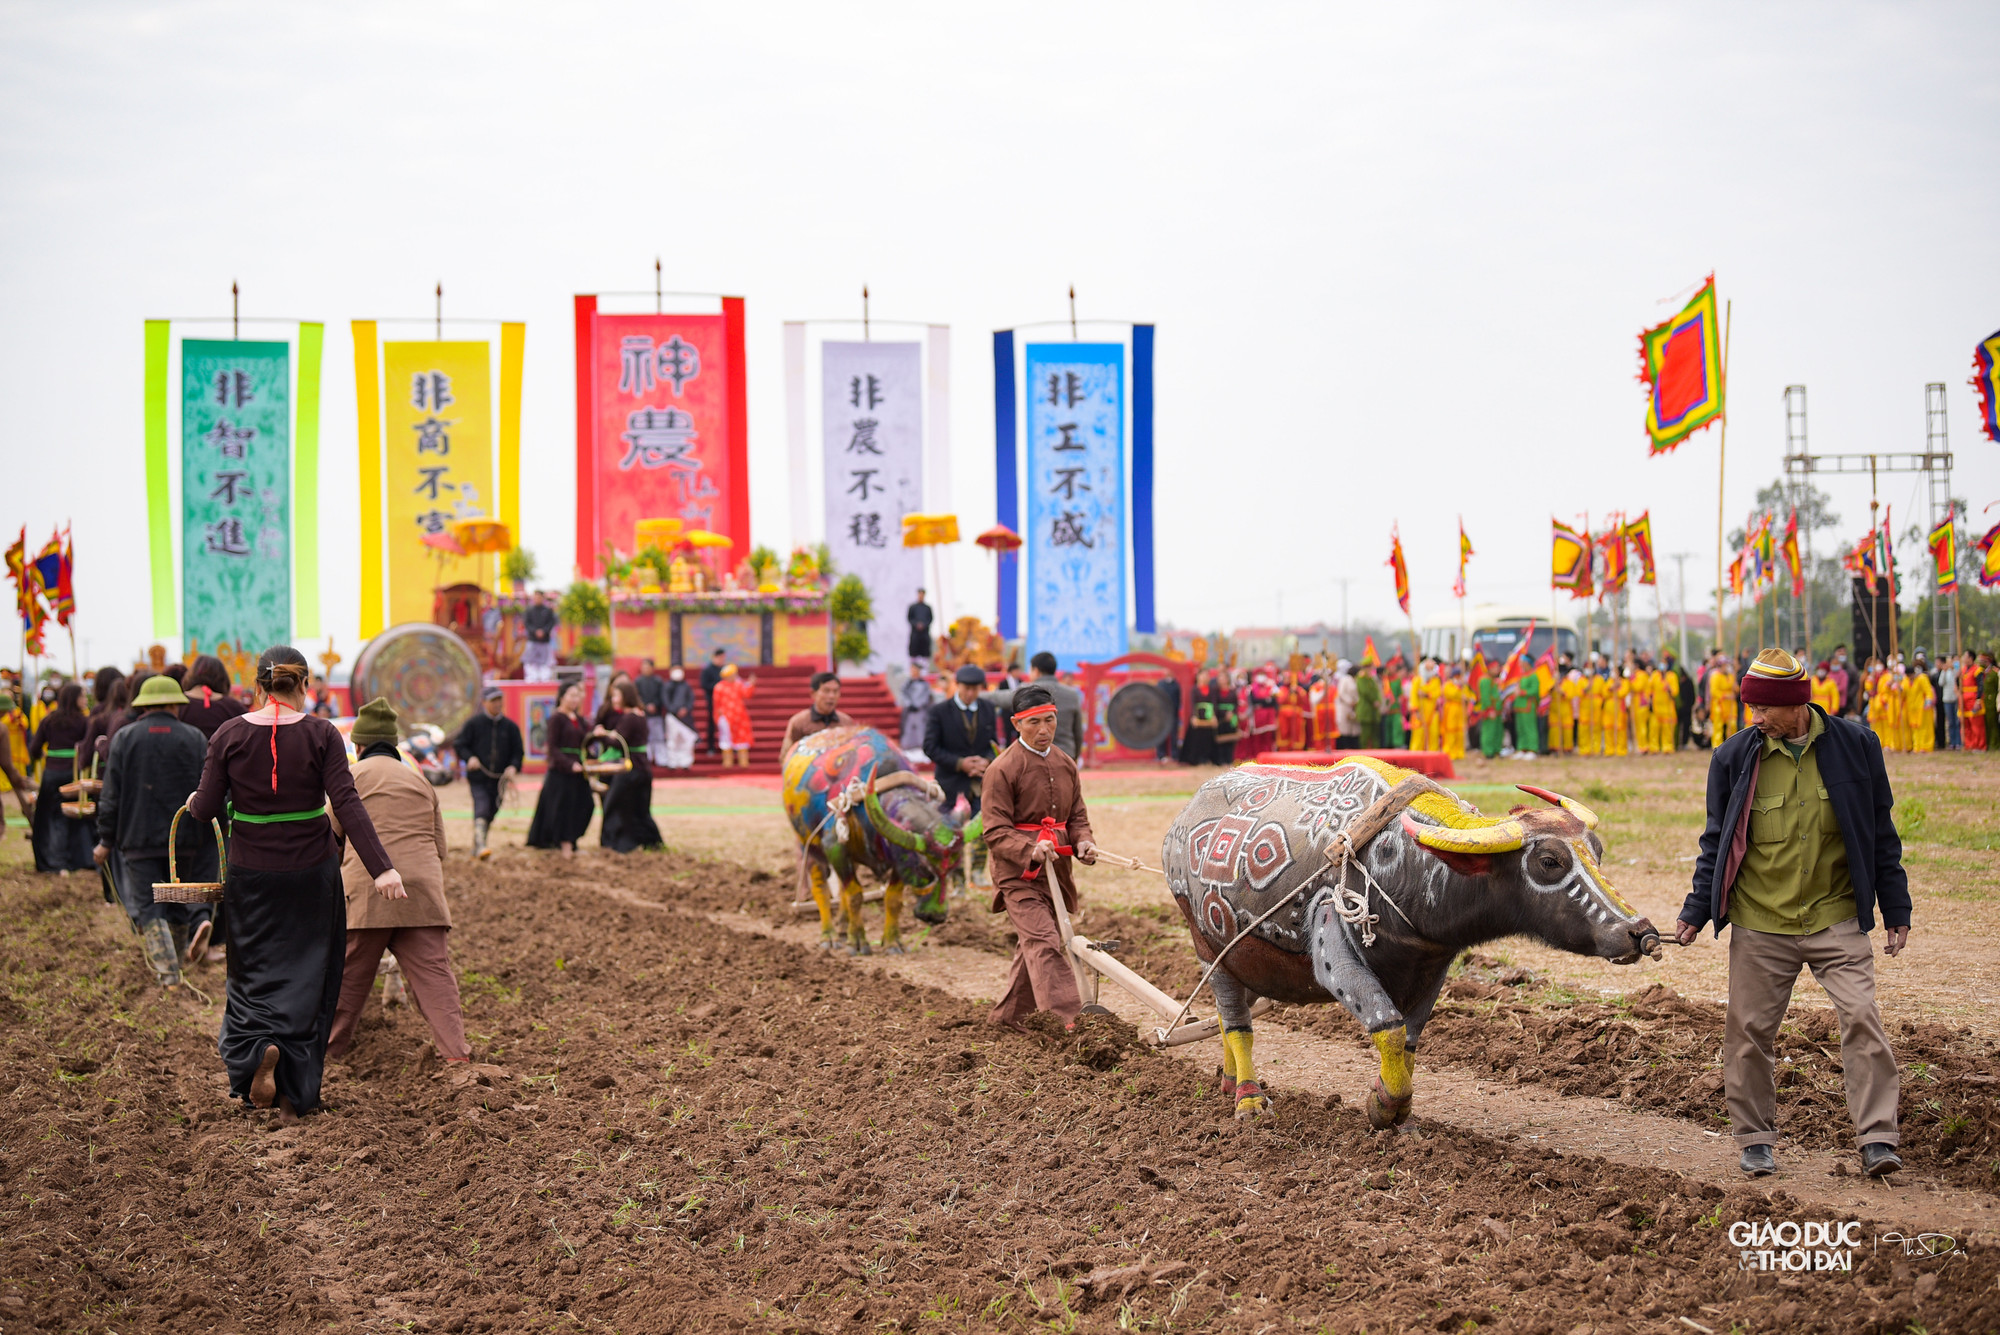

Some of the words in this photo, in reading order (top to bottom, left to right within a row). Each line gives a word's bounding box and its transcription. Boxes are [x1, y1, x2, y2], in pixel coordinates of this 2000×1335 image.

[204, 368, 255, 557] 非智不進
[619, 334, 702, 471] 神農
